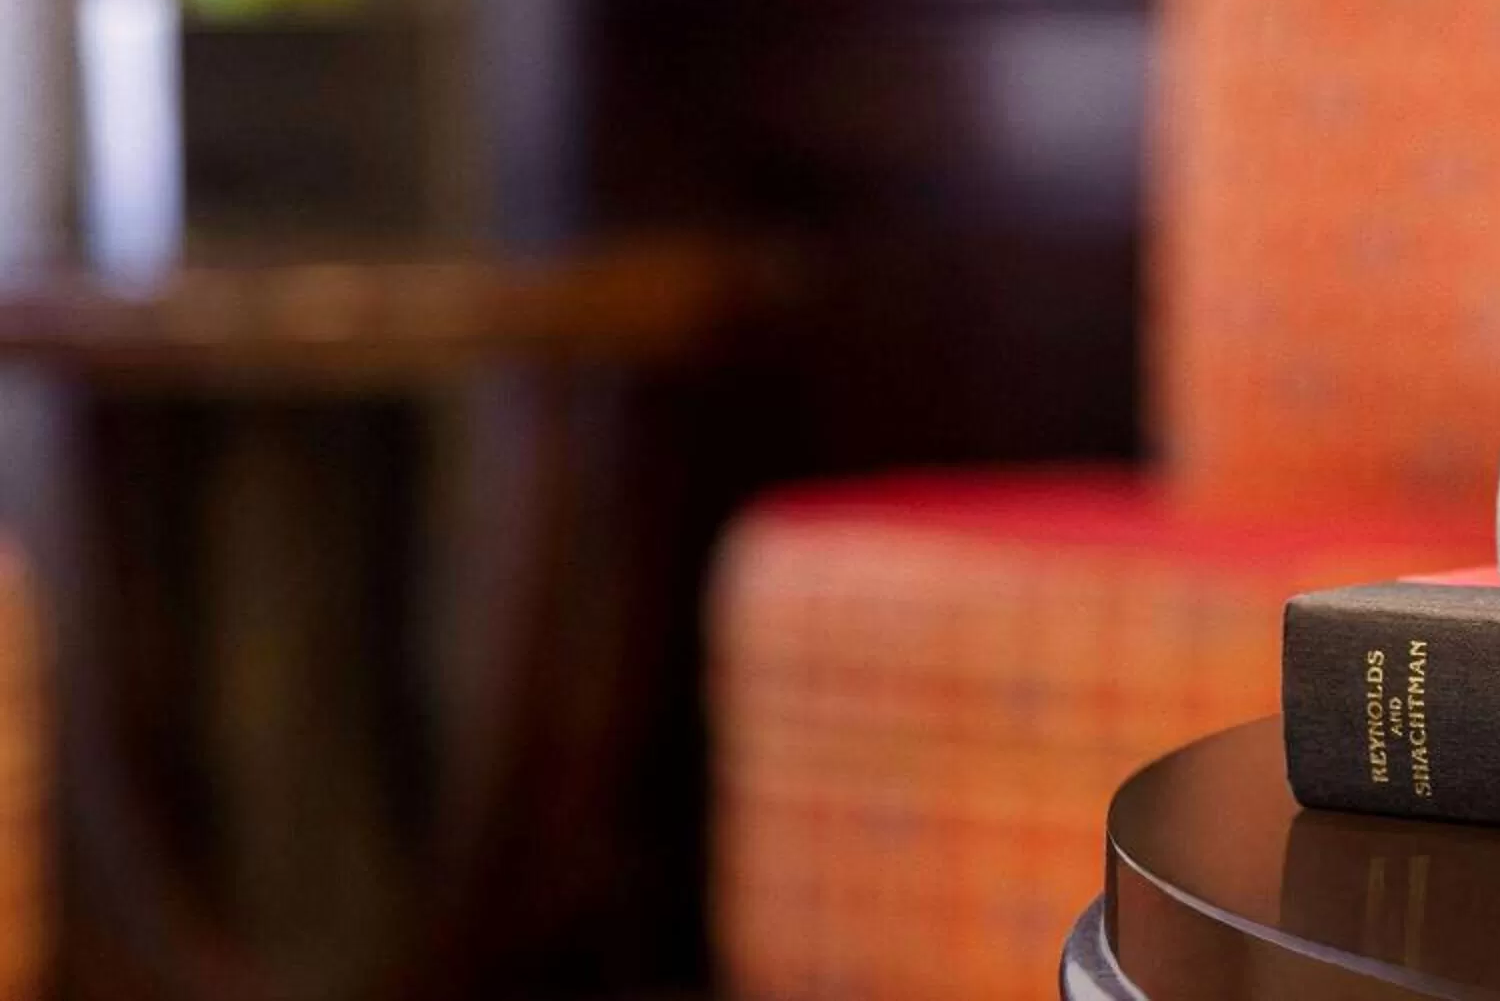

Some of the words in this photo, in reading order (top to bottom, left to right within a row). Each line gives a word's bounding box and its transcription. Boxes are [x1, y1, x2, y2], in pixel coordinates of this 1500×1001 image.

[1366, 648, 1389, 784] REYNOLDS
[1389, 696, 1403, 737] AND
[1407, 639, 1432, 798] SHACHTMAN
